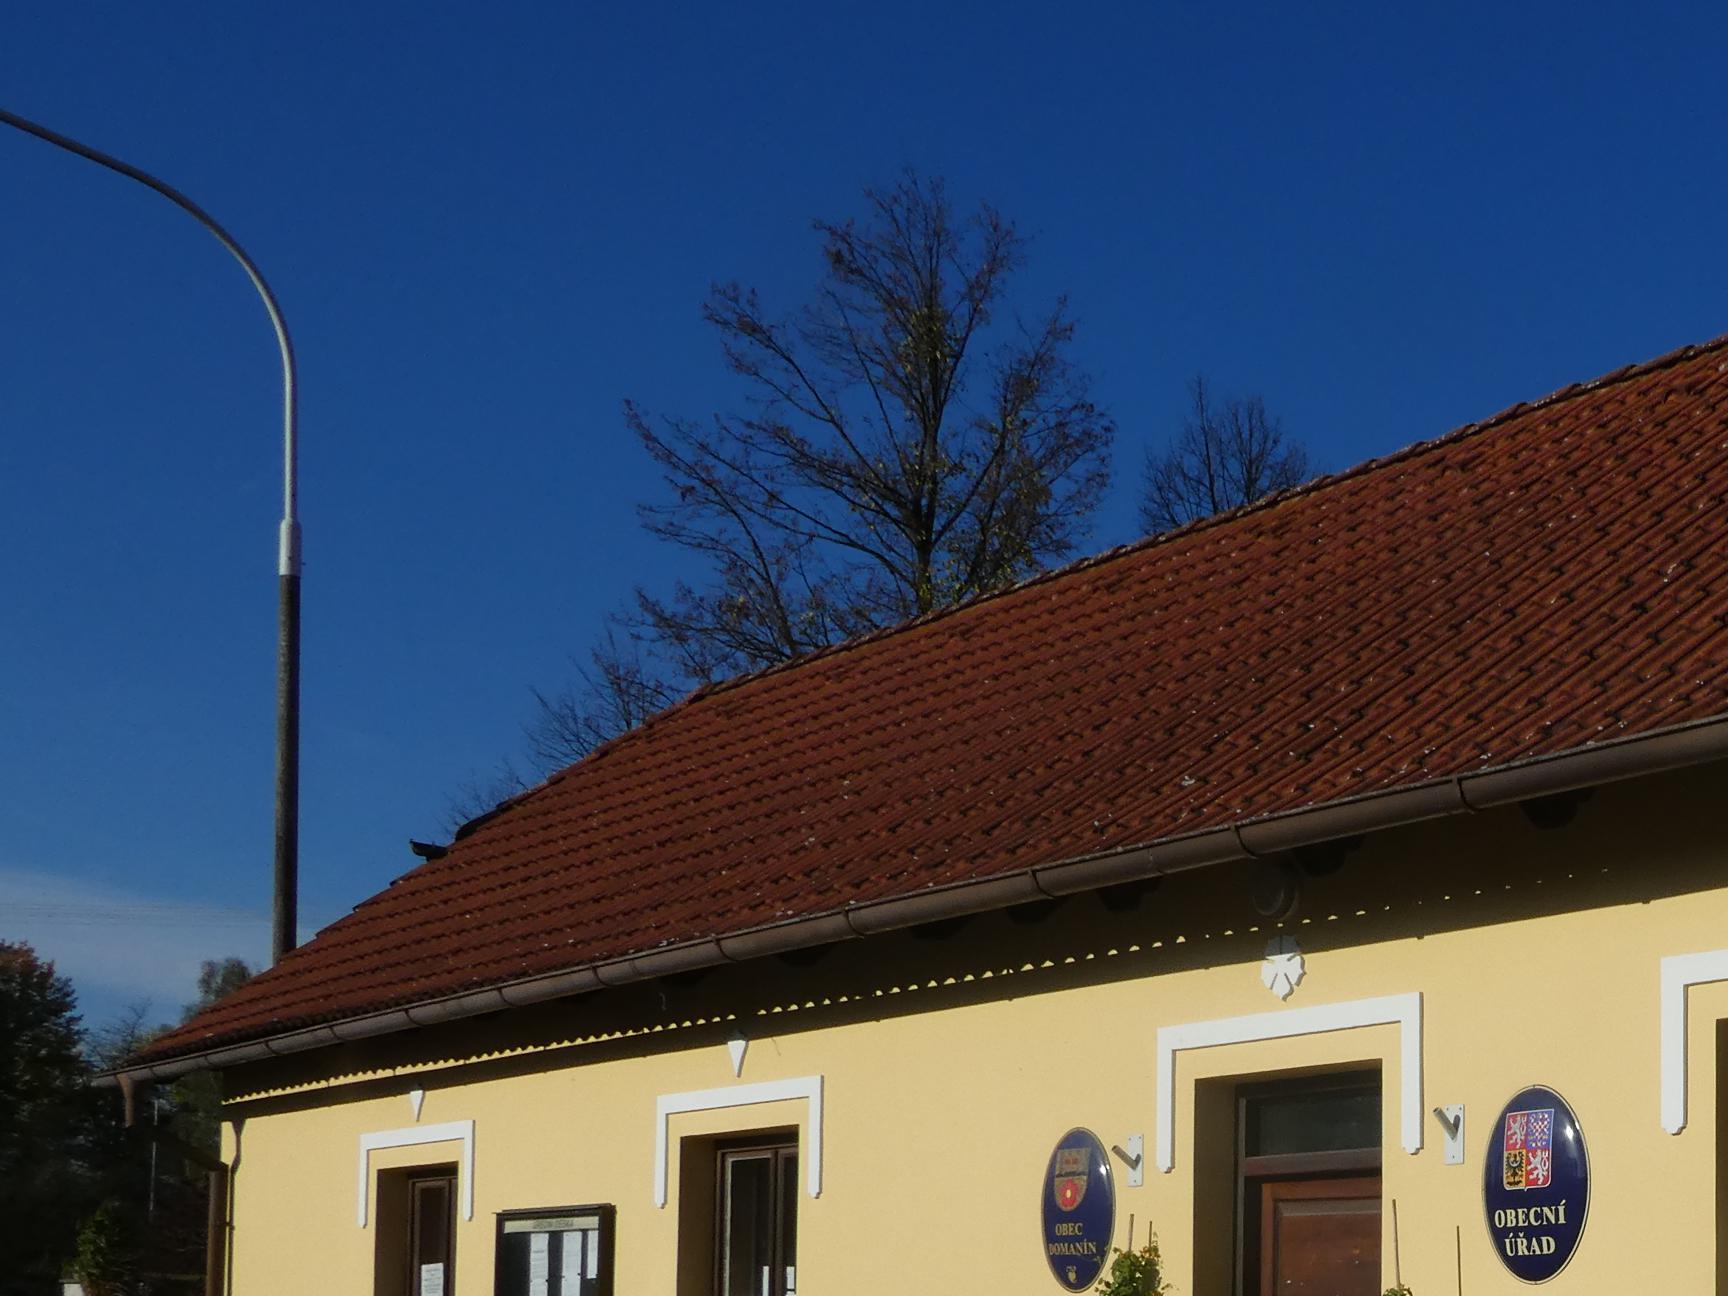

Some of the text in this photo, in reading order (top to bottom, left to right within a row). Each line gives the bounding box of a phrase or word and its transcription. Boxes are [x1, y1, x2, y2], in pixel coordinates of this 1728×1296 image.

[1494, 1199, 1567, 1229] OBECNÍ
[1055, 1222, 1084, 1237] OBEC
[1048, 1238, 1097, 1256] DOMANÍN
[1504, 1231, 1556, 1257] ÚŘAD
